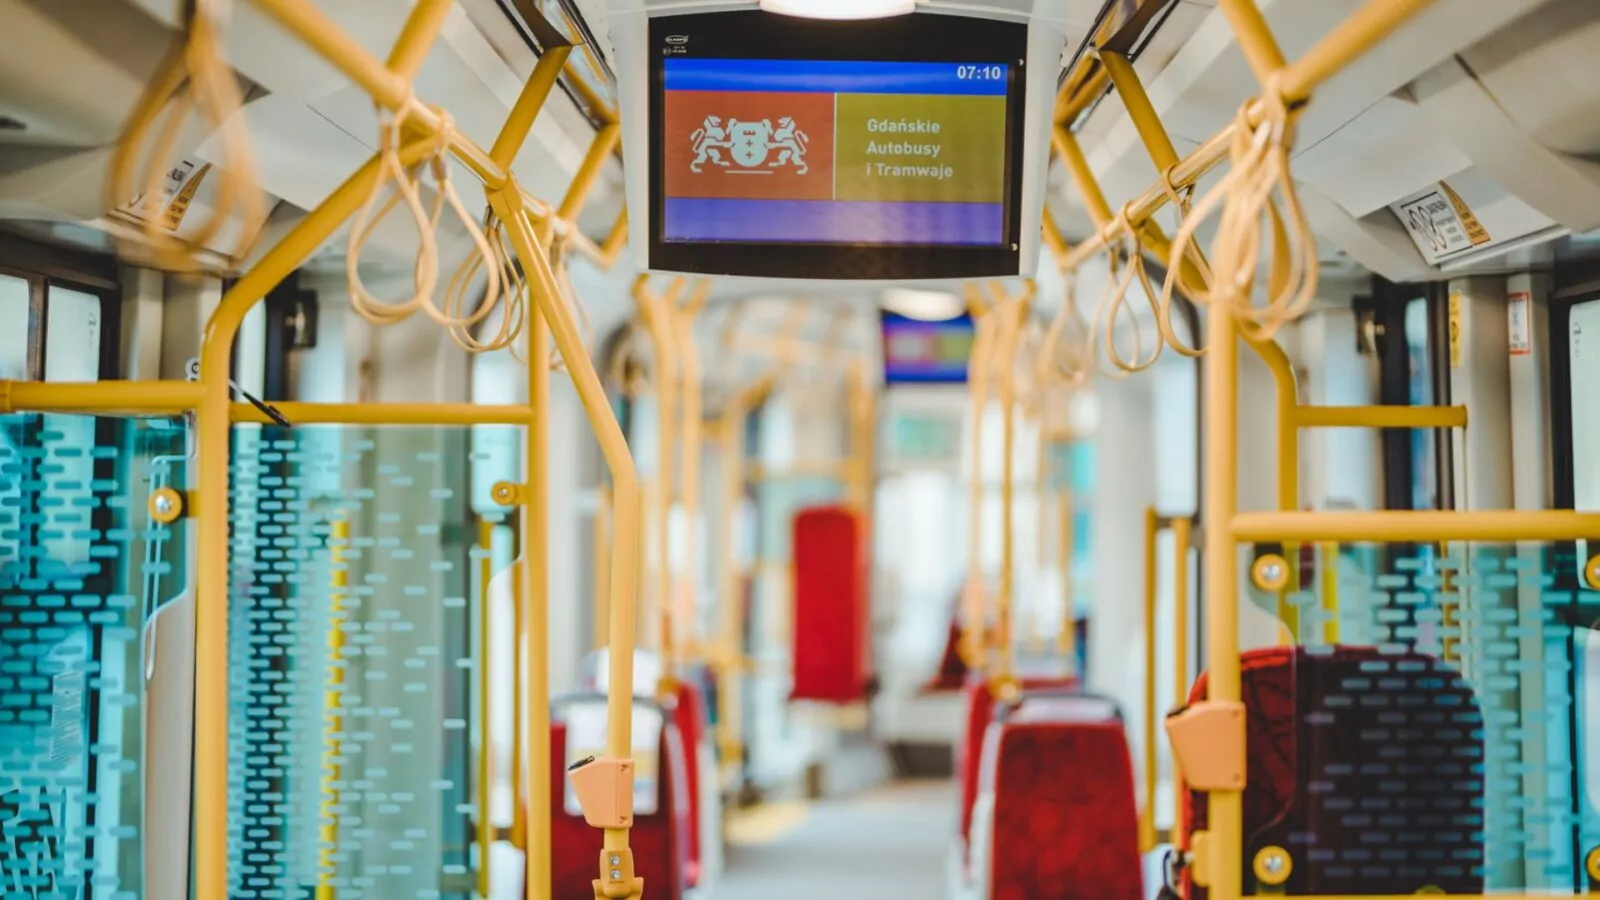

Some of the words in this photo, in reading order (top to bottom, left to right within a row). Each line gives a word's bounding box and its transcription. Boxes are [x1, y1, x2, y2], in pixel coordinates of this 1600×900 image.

[957, 65, 1001, 80] 07:10
[867, 117, 941, 133] Gdańskie
[866, 140, 941, 158] Autobusy
[866, 161, 871, 176] i
[876, 162, 953, 180] Tramwaje
